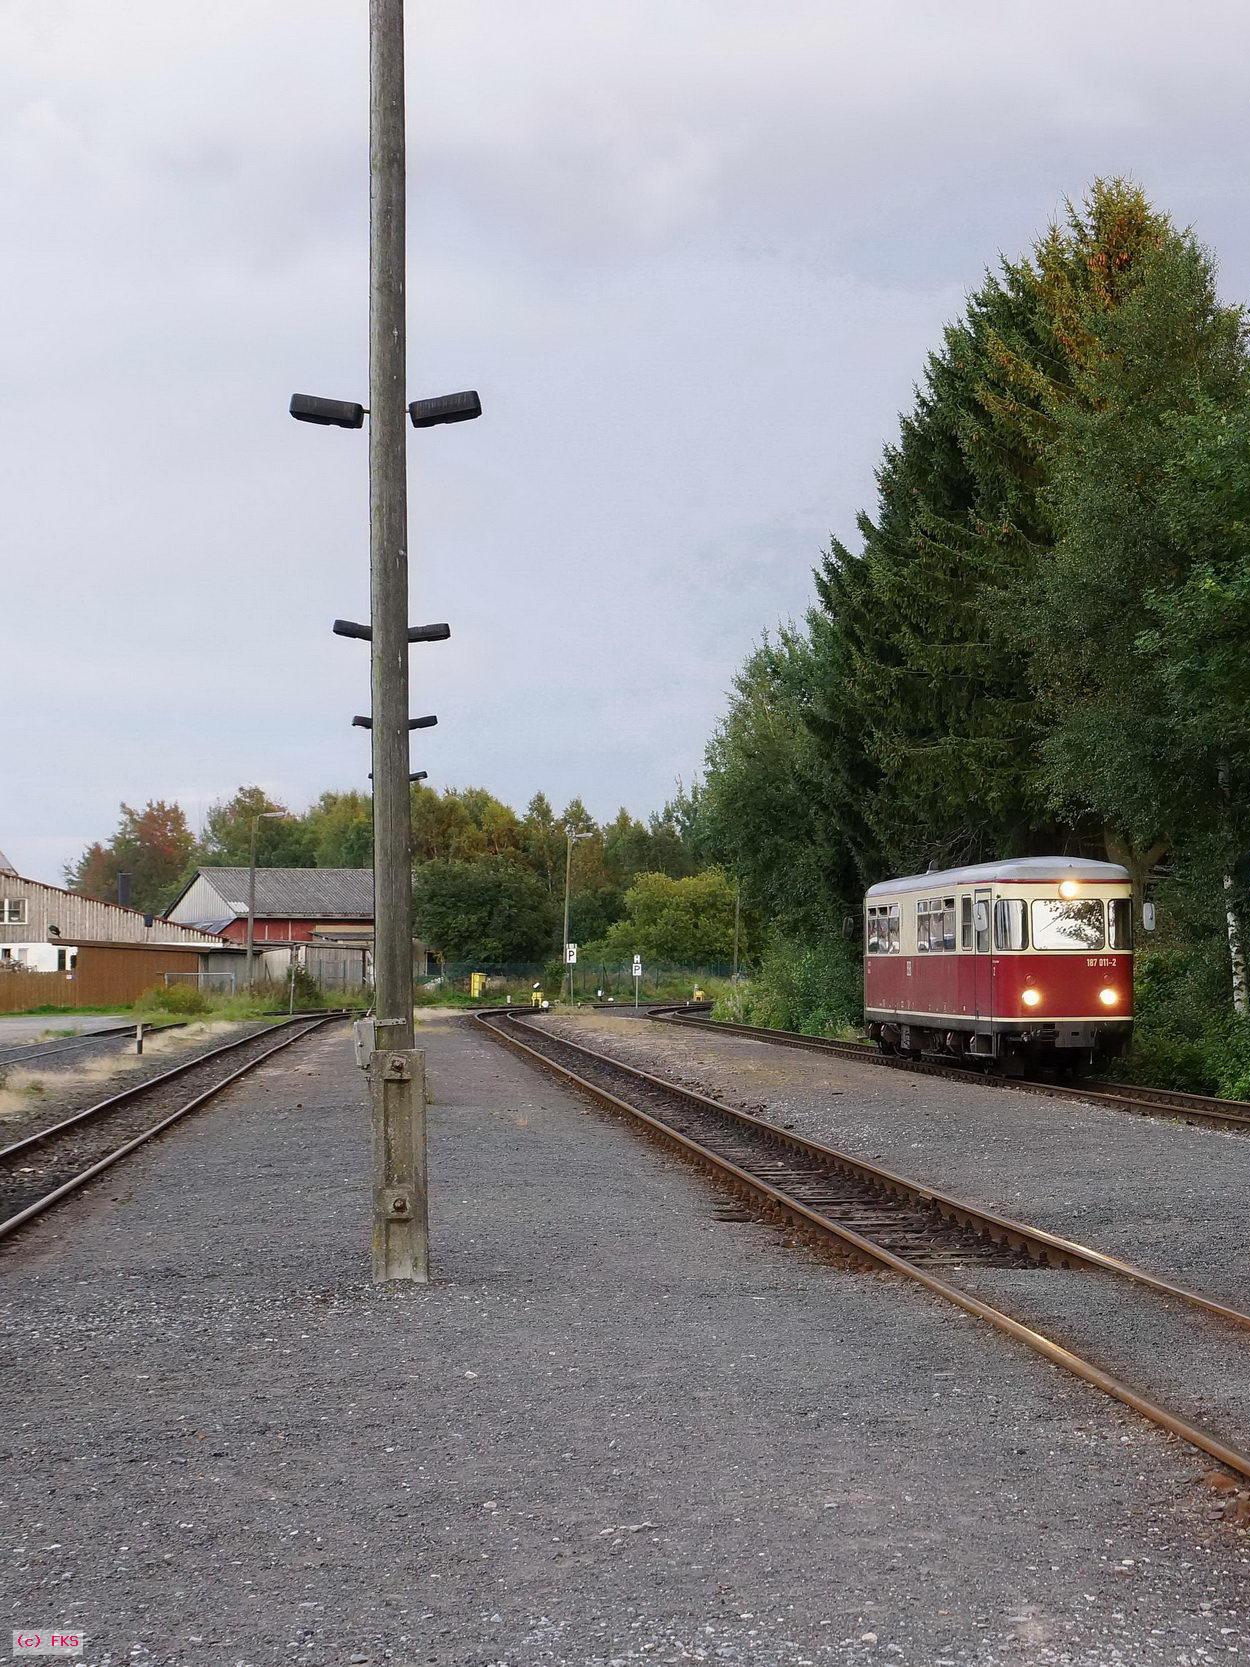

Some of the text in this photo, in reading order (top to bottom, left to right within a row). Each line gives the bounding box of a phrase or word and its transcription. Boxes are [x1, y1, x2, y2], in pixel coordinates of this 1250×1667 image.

[568, 950, 575, 961] P
[1086, 958, 1117, 967] 187 011-2
